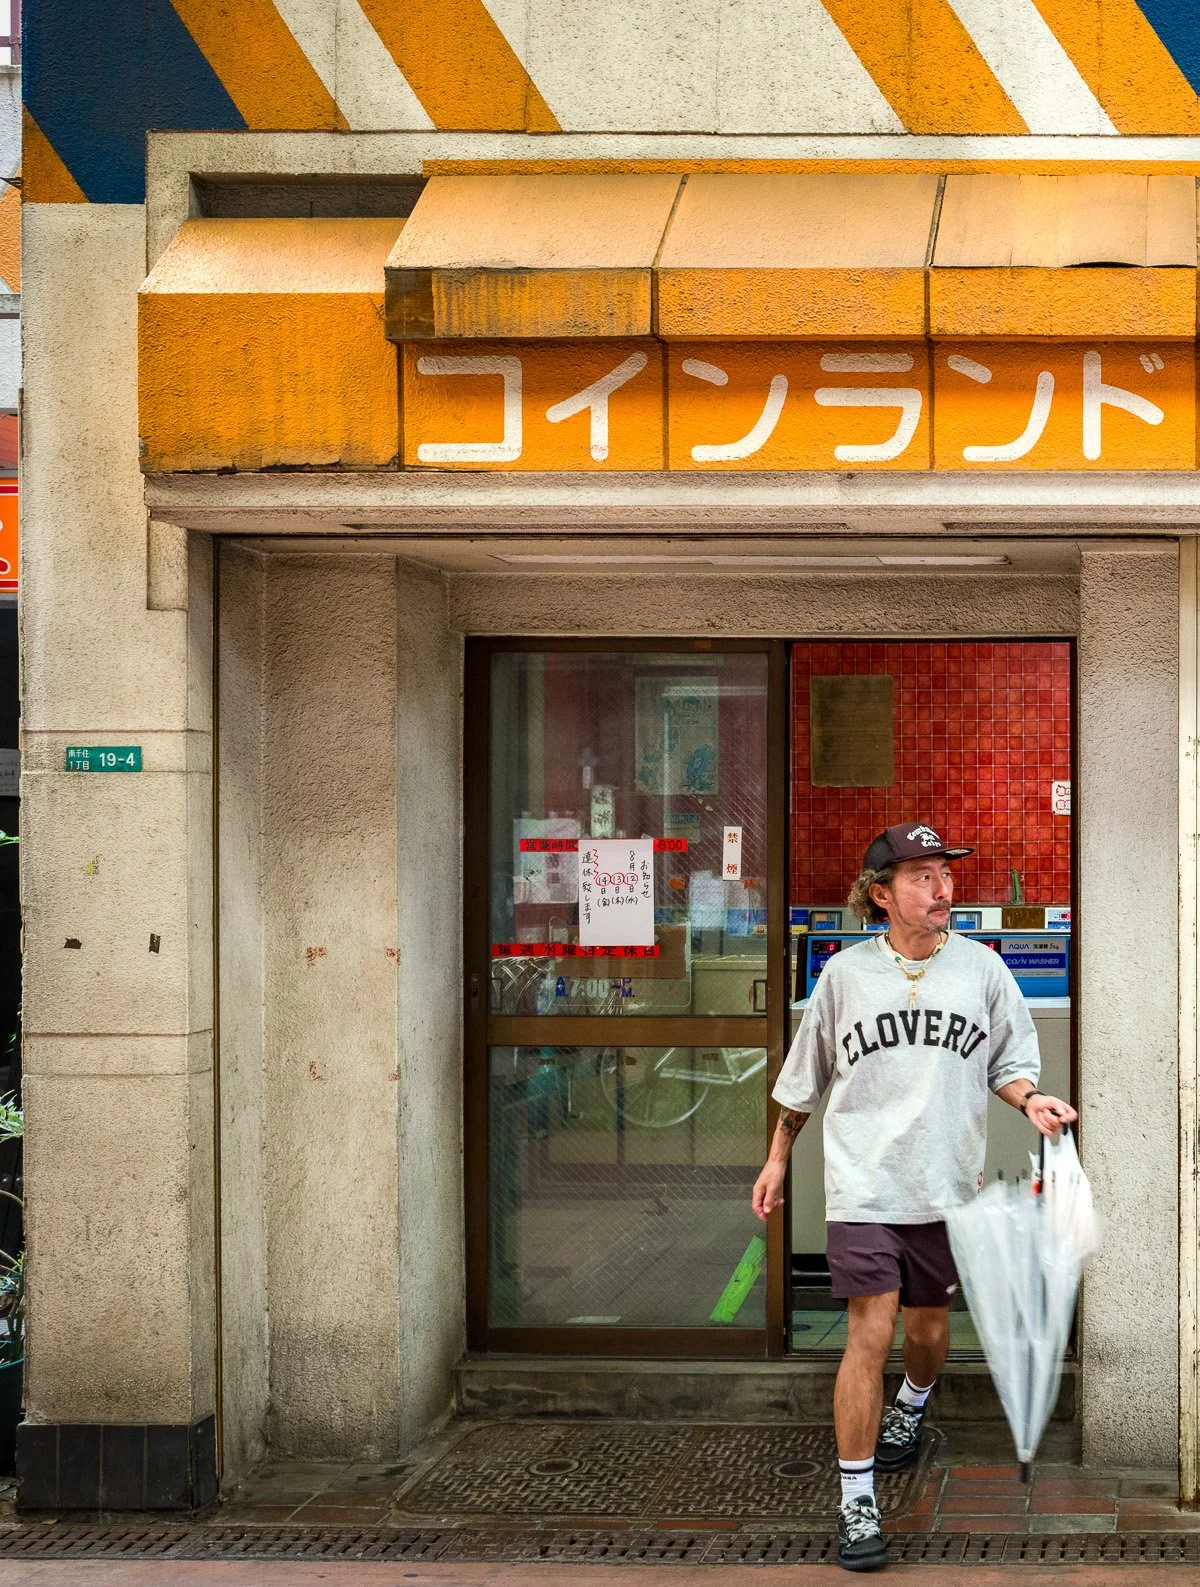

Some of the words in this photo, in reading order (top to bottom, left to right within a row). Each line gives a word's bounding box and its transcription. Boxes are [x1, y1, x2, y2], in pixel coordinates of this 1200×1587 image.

[68, 749, 90, 758] 南千住
[69, 760, 90, 771] 1丁目
[99, 752, 136, 767] 19-4
[726, 832, 739, 875] 禁煙
[640, 859, 652, 899] お知らせ
[842, 1009, 988, 1067] CLOVERU
